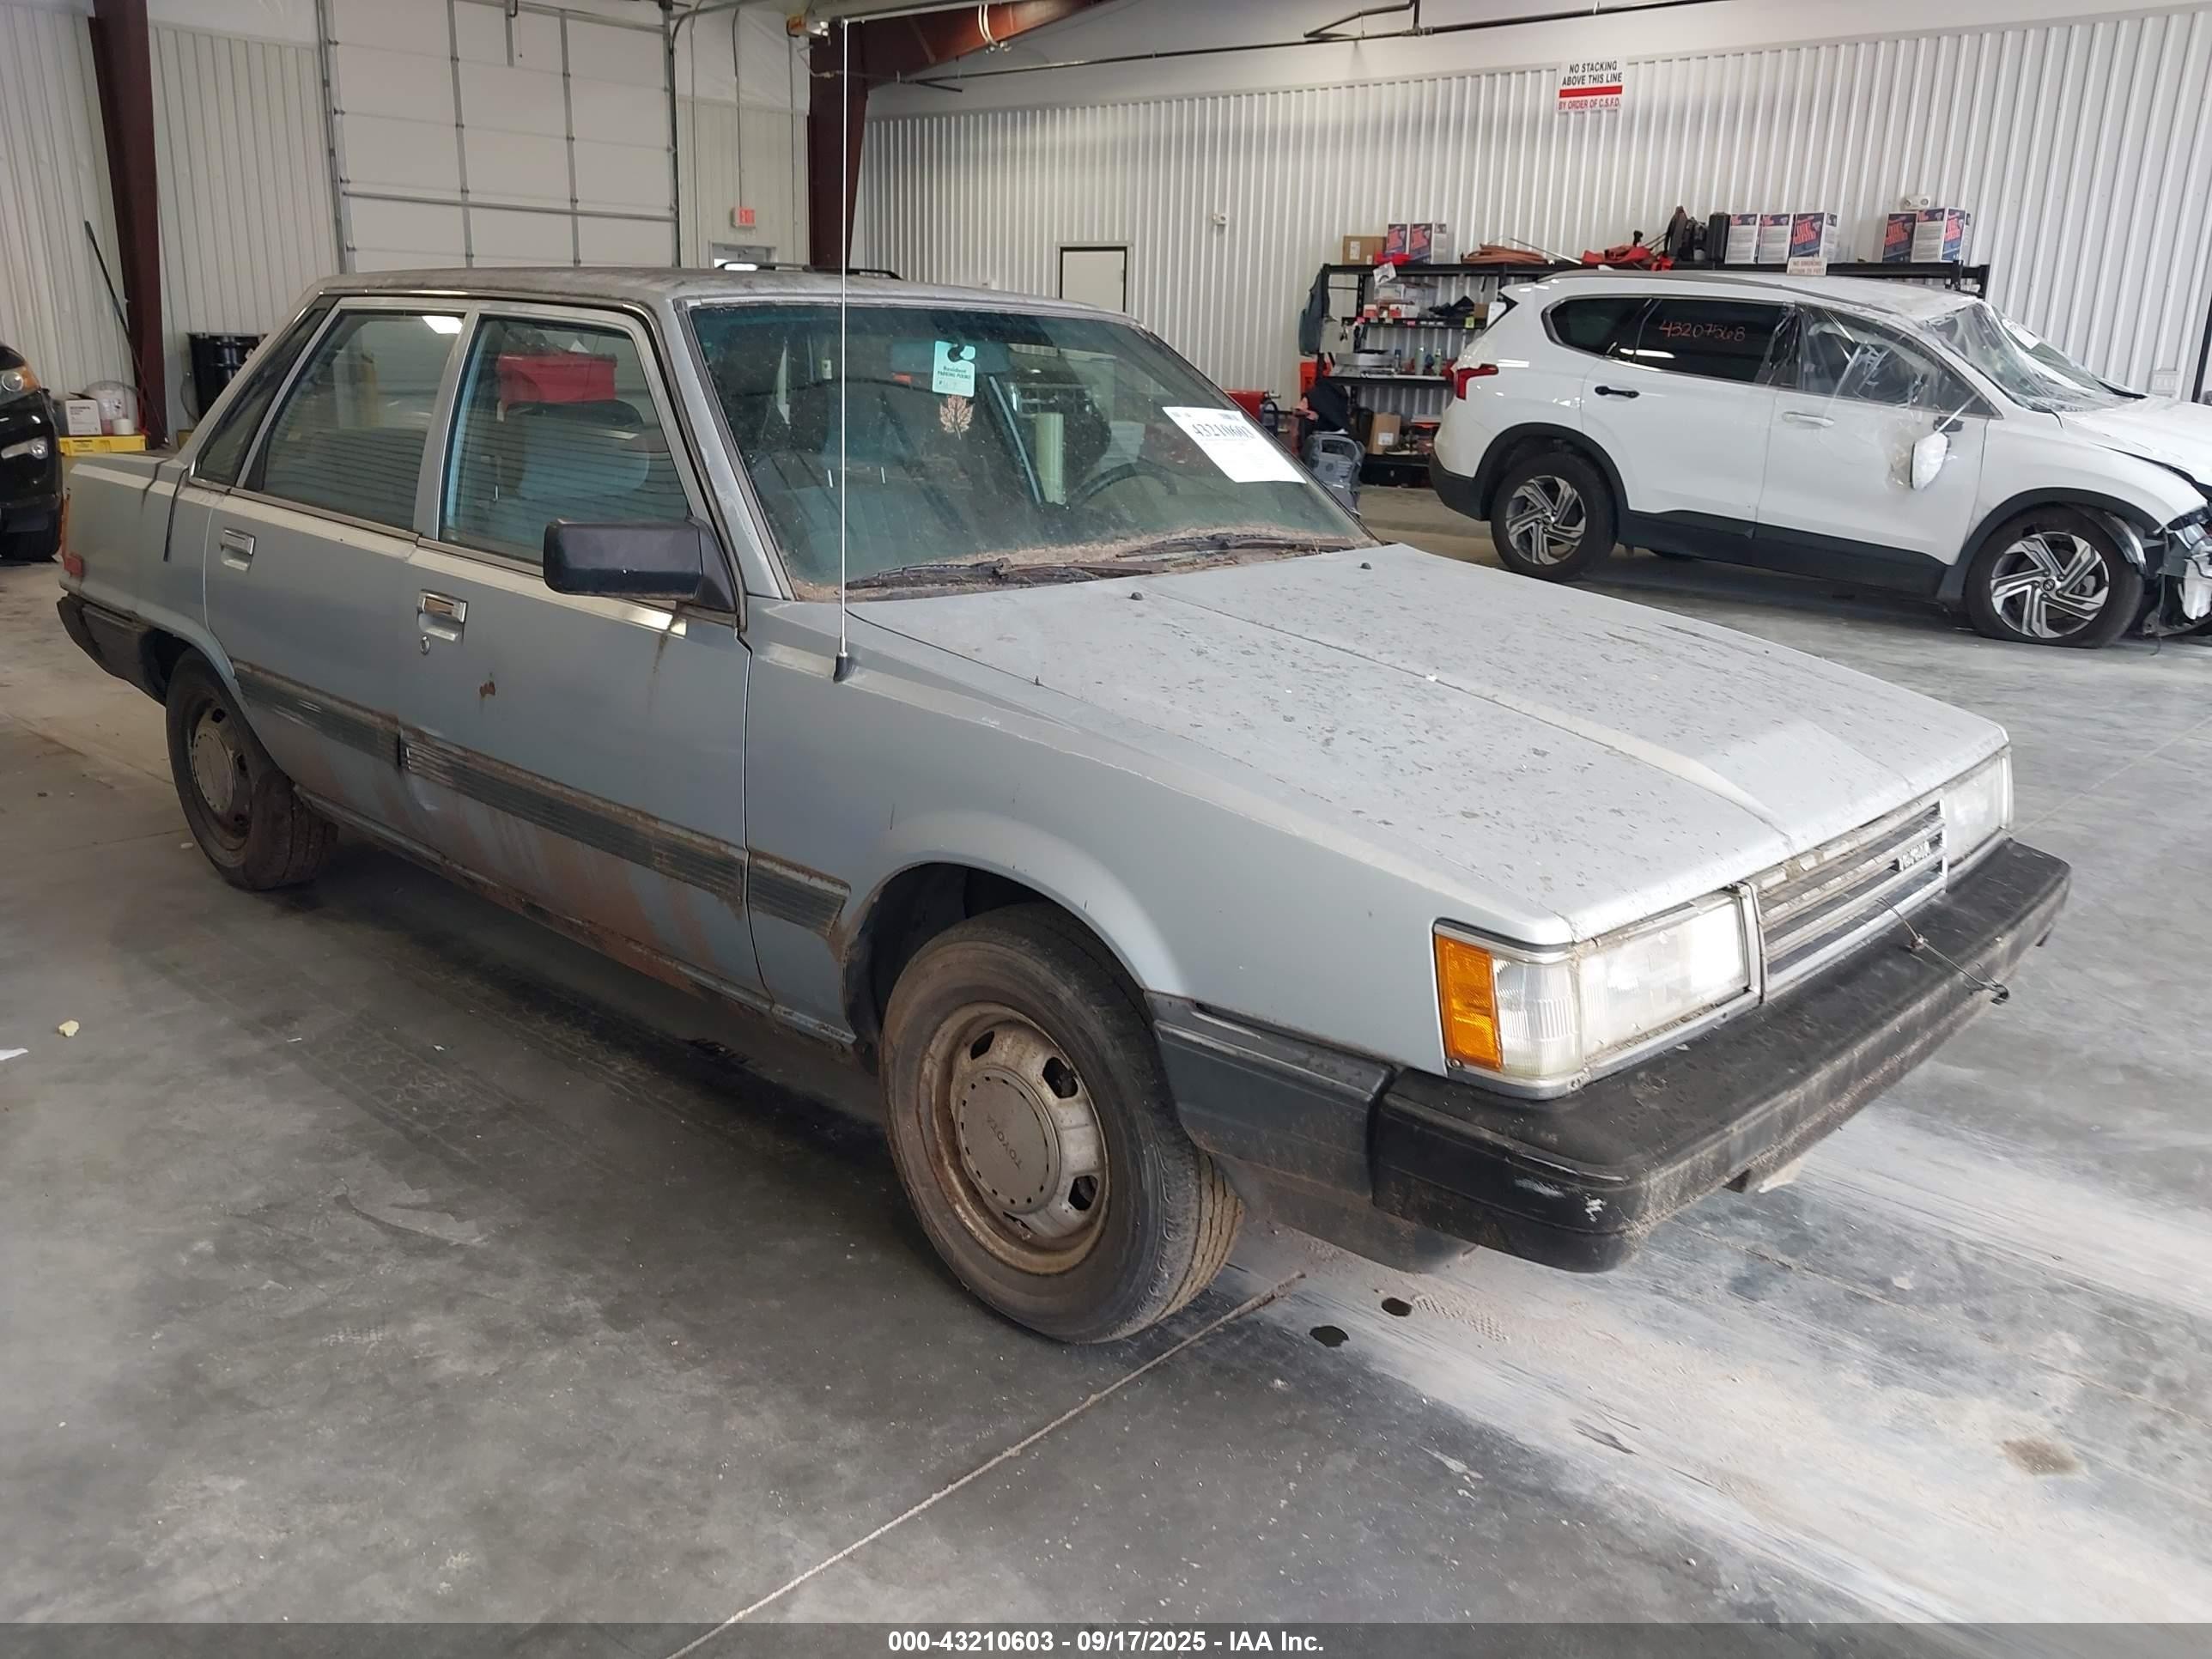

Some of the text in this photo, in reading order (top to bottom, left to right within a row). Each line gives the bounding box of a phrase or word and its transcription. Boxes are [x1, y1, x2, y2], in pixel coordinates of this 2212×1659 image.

[1569, 60, 1617, 74] NO STACKING
[1562, 72, 1622, 86] ABOVE THIS LINE
[1559, 101, 1566, 110] BY
[1568, 100, 1588, 110] ORDER
[1589, 99, 1598, 108] OF
[1659, 319, 1745, 342] 43207568
[1192, 423, 1256, 440] 43210603
[987, 1114, 1022, 1170] TOYOTA
